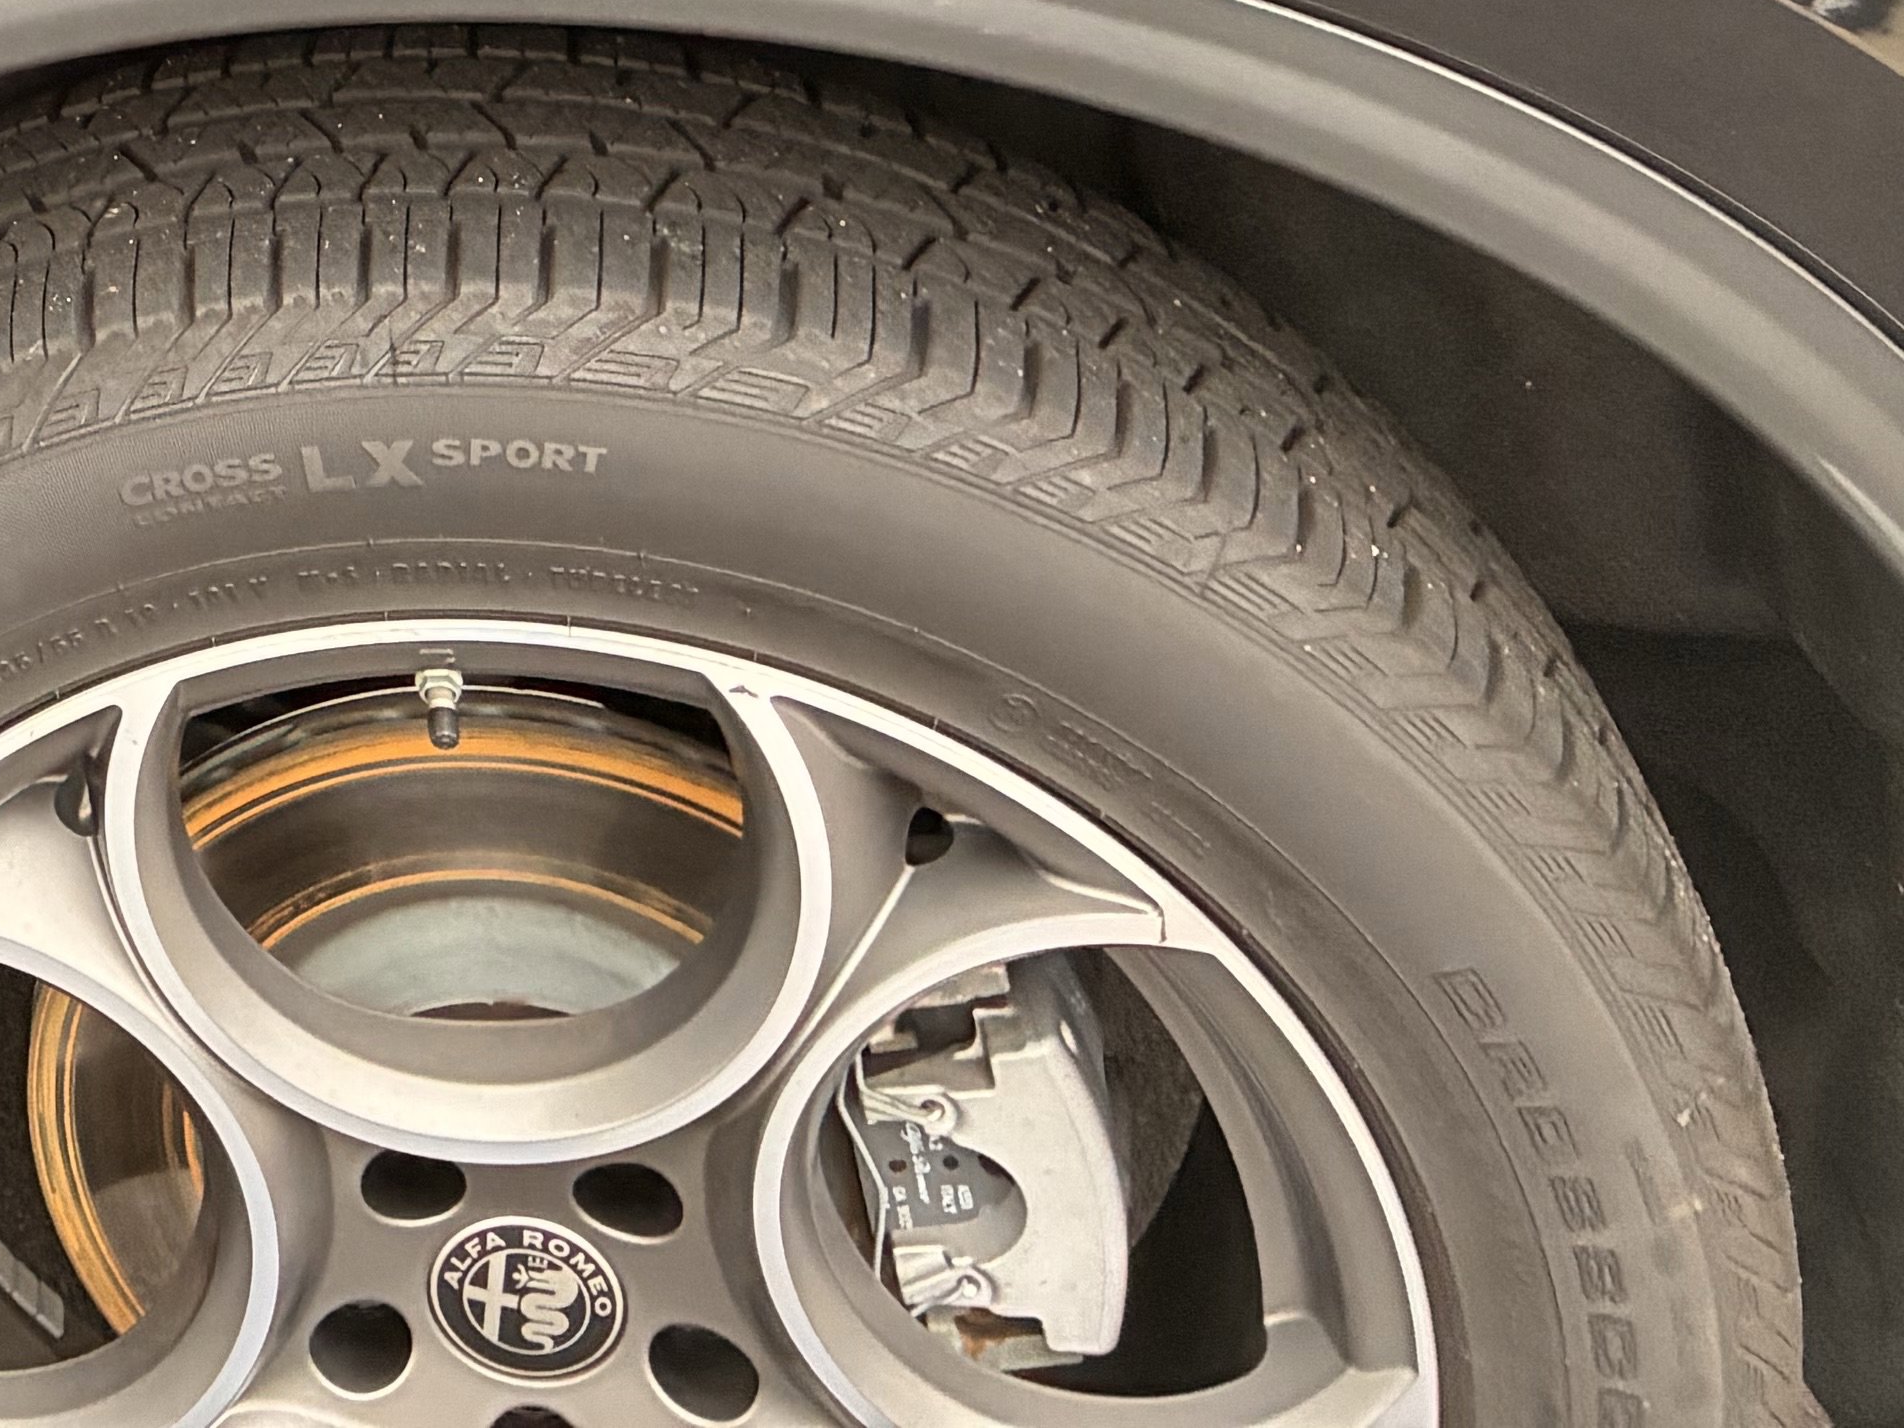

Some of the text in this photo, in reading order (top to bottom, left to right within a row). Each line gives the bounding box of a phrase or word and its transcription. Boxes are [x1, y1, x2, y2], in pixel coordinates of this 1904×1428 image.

[119, 452, 283, 506] CROSS
[432, 439, 608, 474] SPORT
[442, 1228, 614, 1319] ALFA ROMEO
